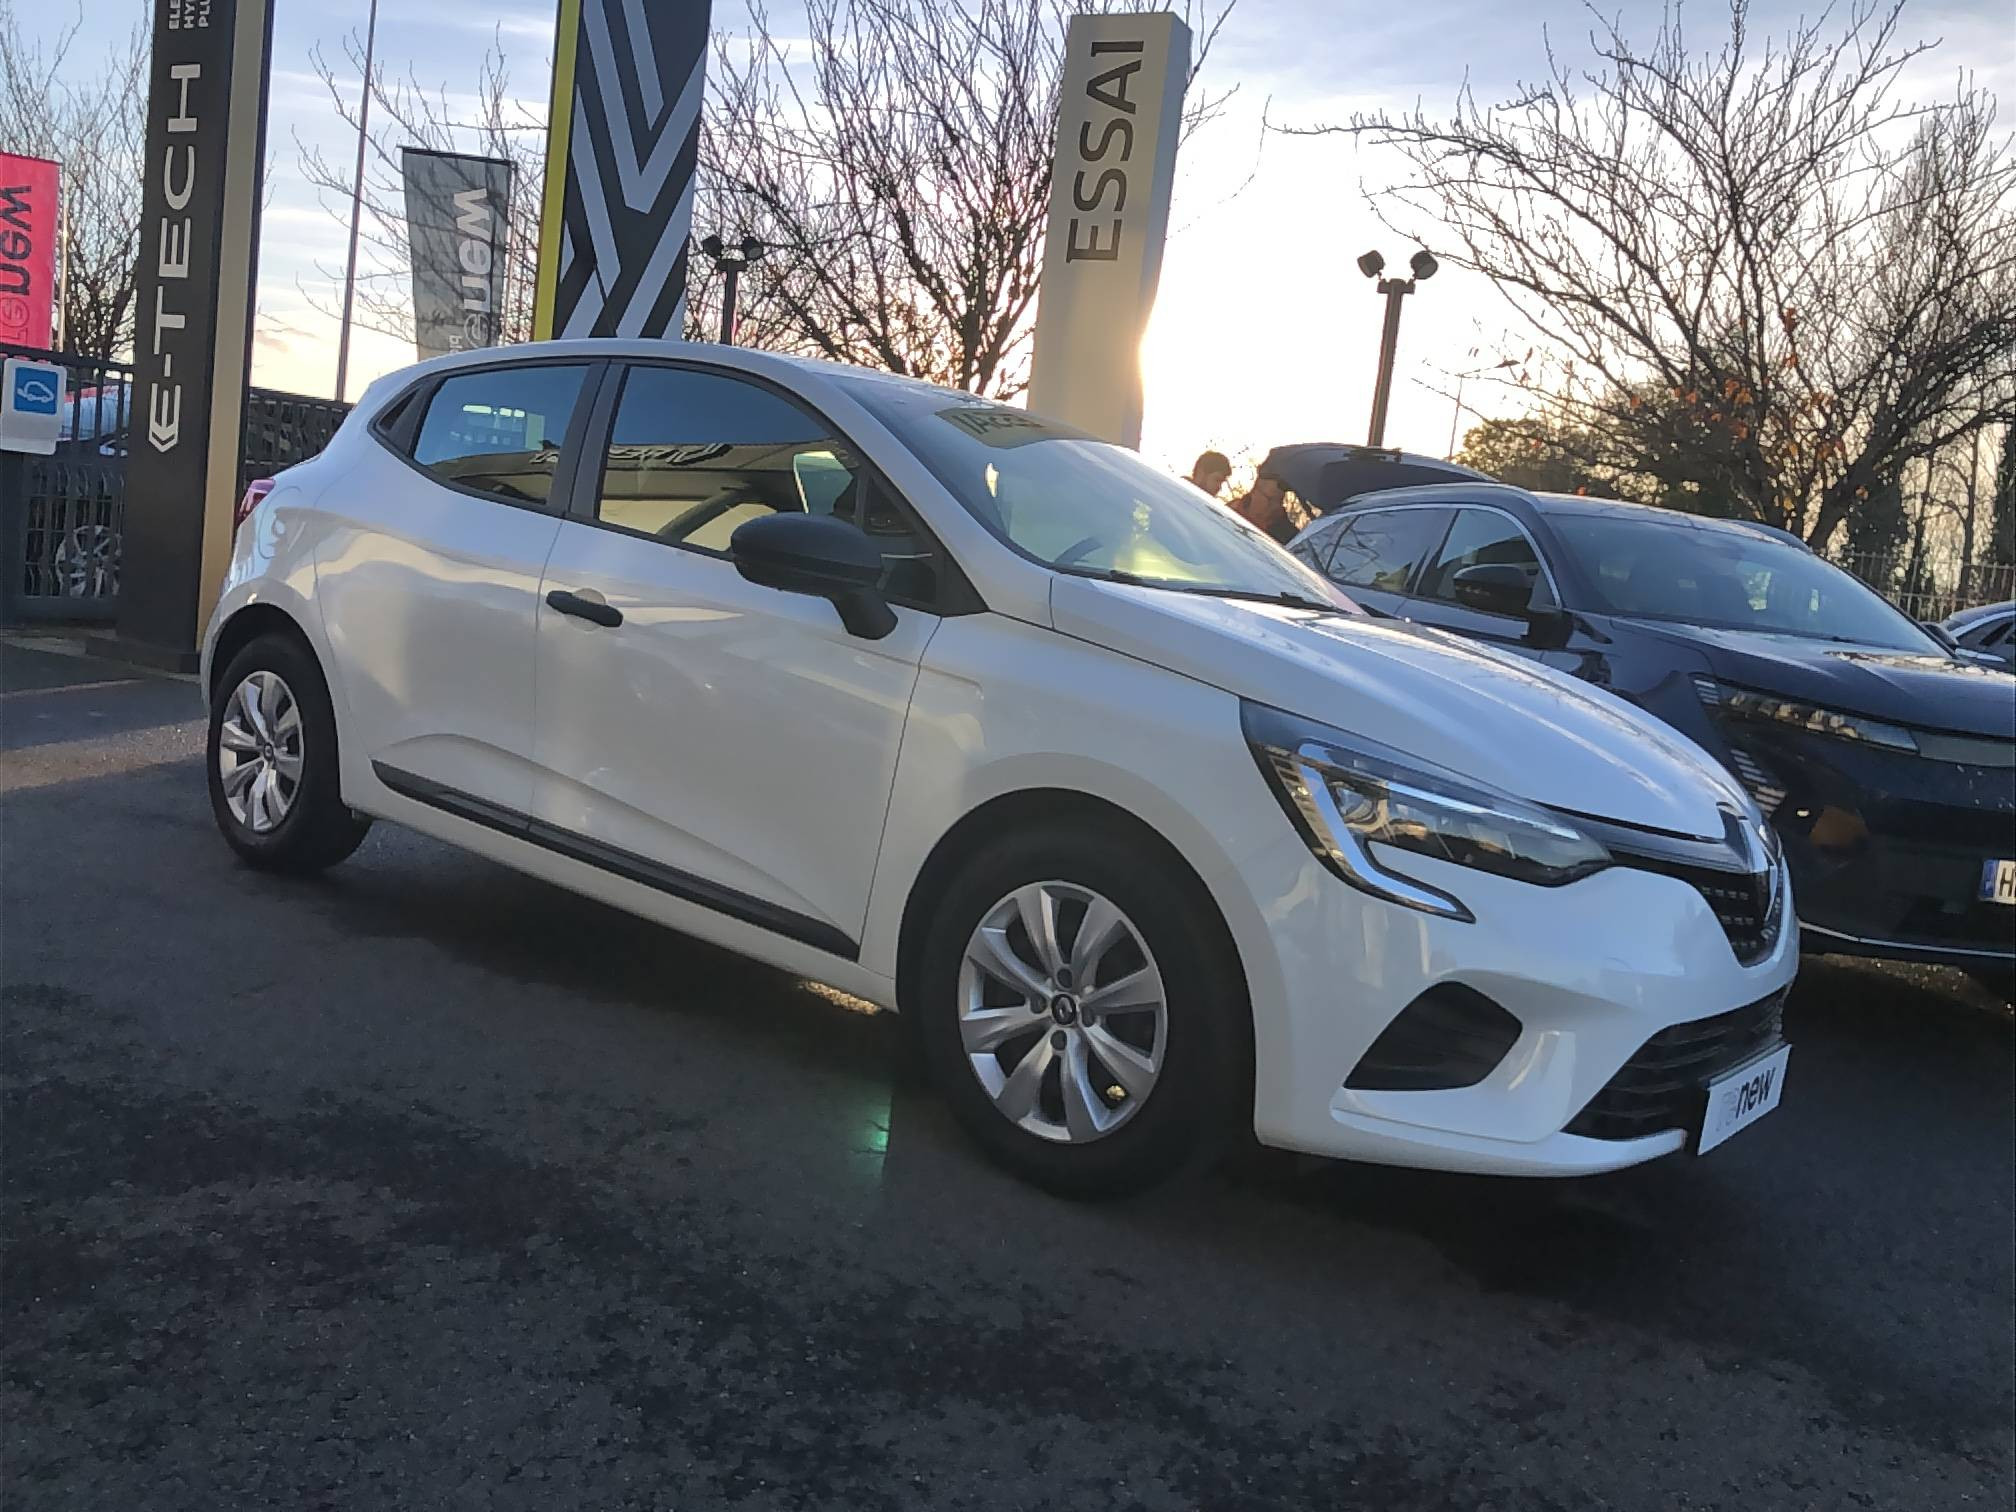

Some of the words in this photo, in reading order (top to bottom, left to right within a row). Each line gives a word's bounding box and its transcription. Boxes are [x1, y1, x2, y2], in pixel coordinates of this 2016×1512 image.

[184, 0, 195, 28] HY
[149, 64, 201, 452] E-TECH
[1066, 41, 1144, 263] ESSAI
